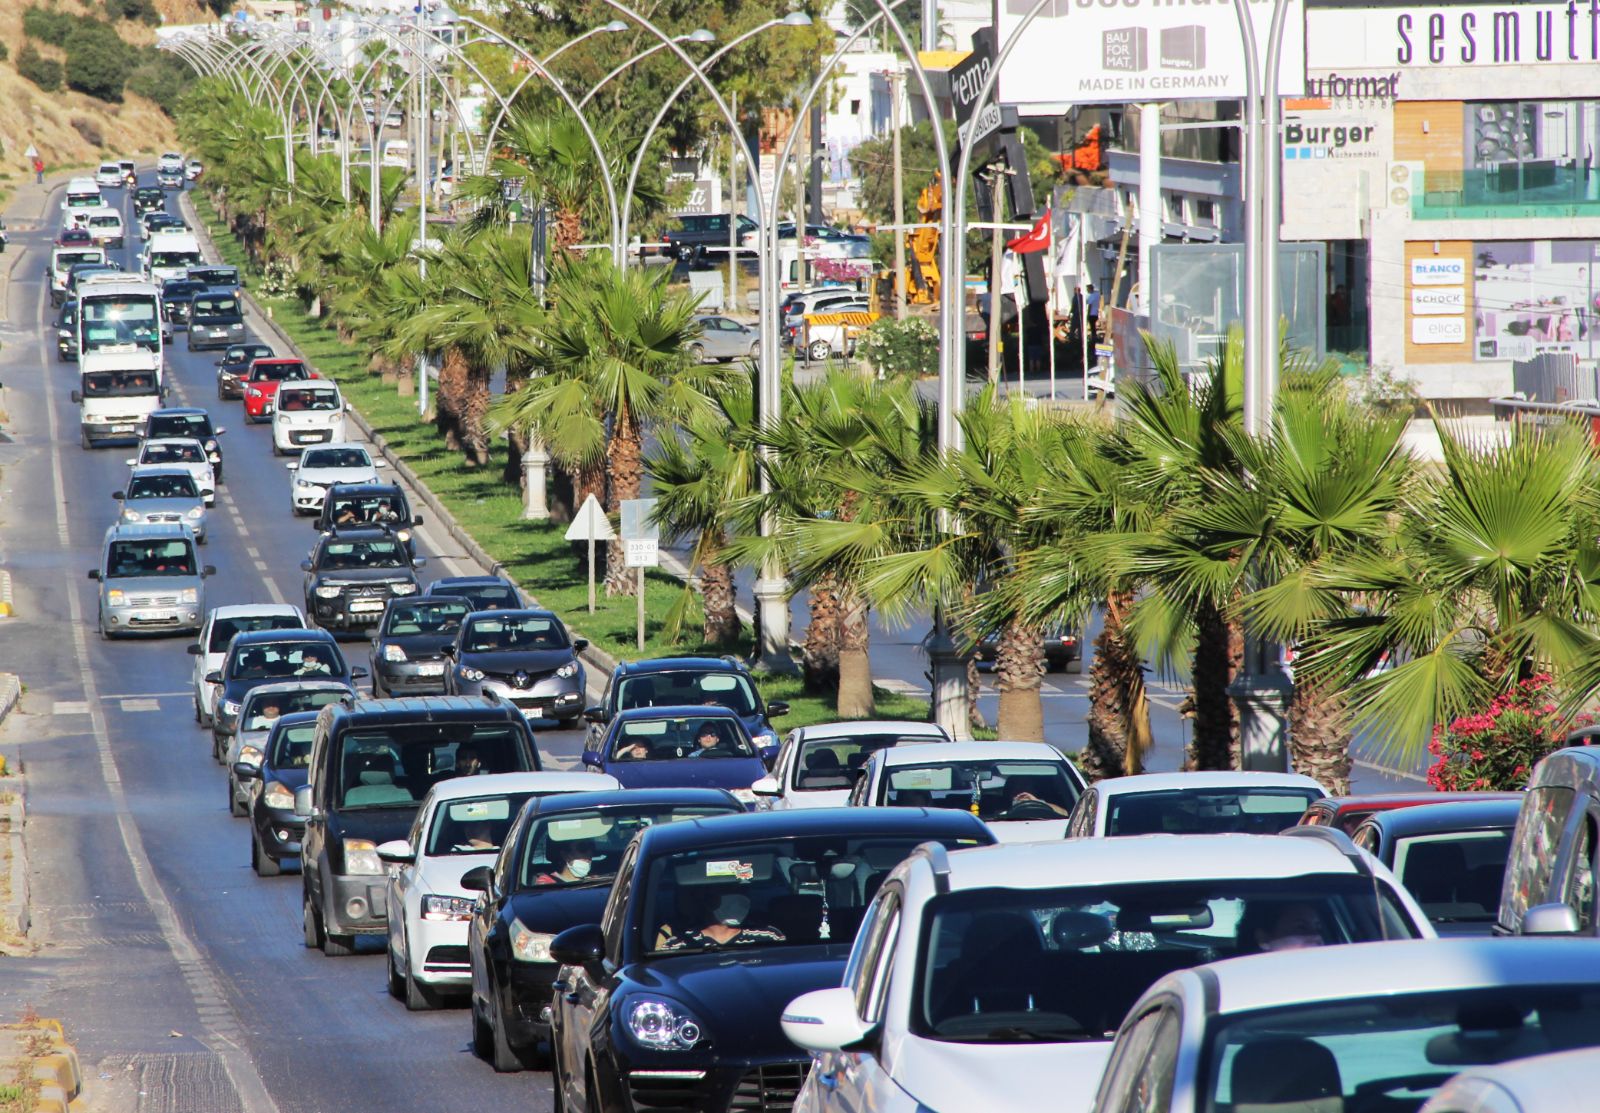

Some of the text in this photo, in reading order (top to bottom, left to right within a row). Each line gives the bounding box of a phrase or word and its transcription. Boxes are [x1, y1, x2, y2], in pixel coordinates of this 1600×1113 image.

[1106, 32, 1130, 44] BAU
[1106, 45, 1130, 56] FOR
[1079, 75, 1229, 91] MADE IN GERMANY
[1285, 116, 1374, 147] Burger
[1415, 264, 1461, 274] BLANCO
[1416, 294, 1461, 304] SCHOCK
[1428, 321, 1462, 334] elica
